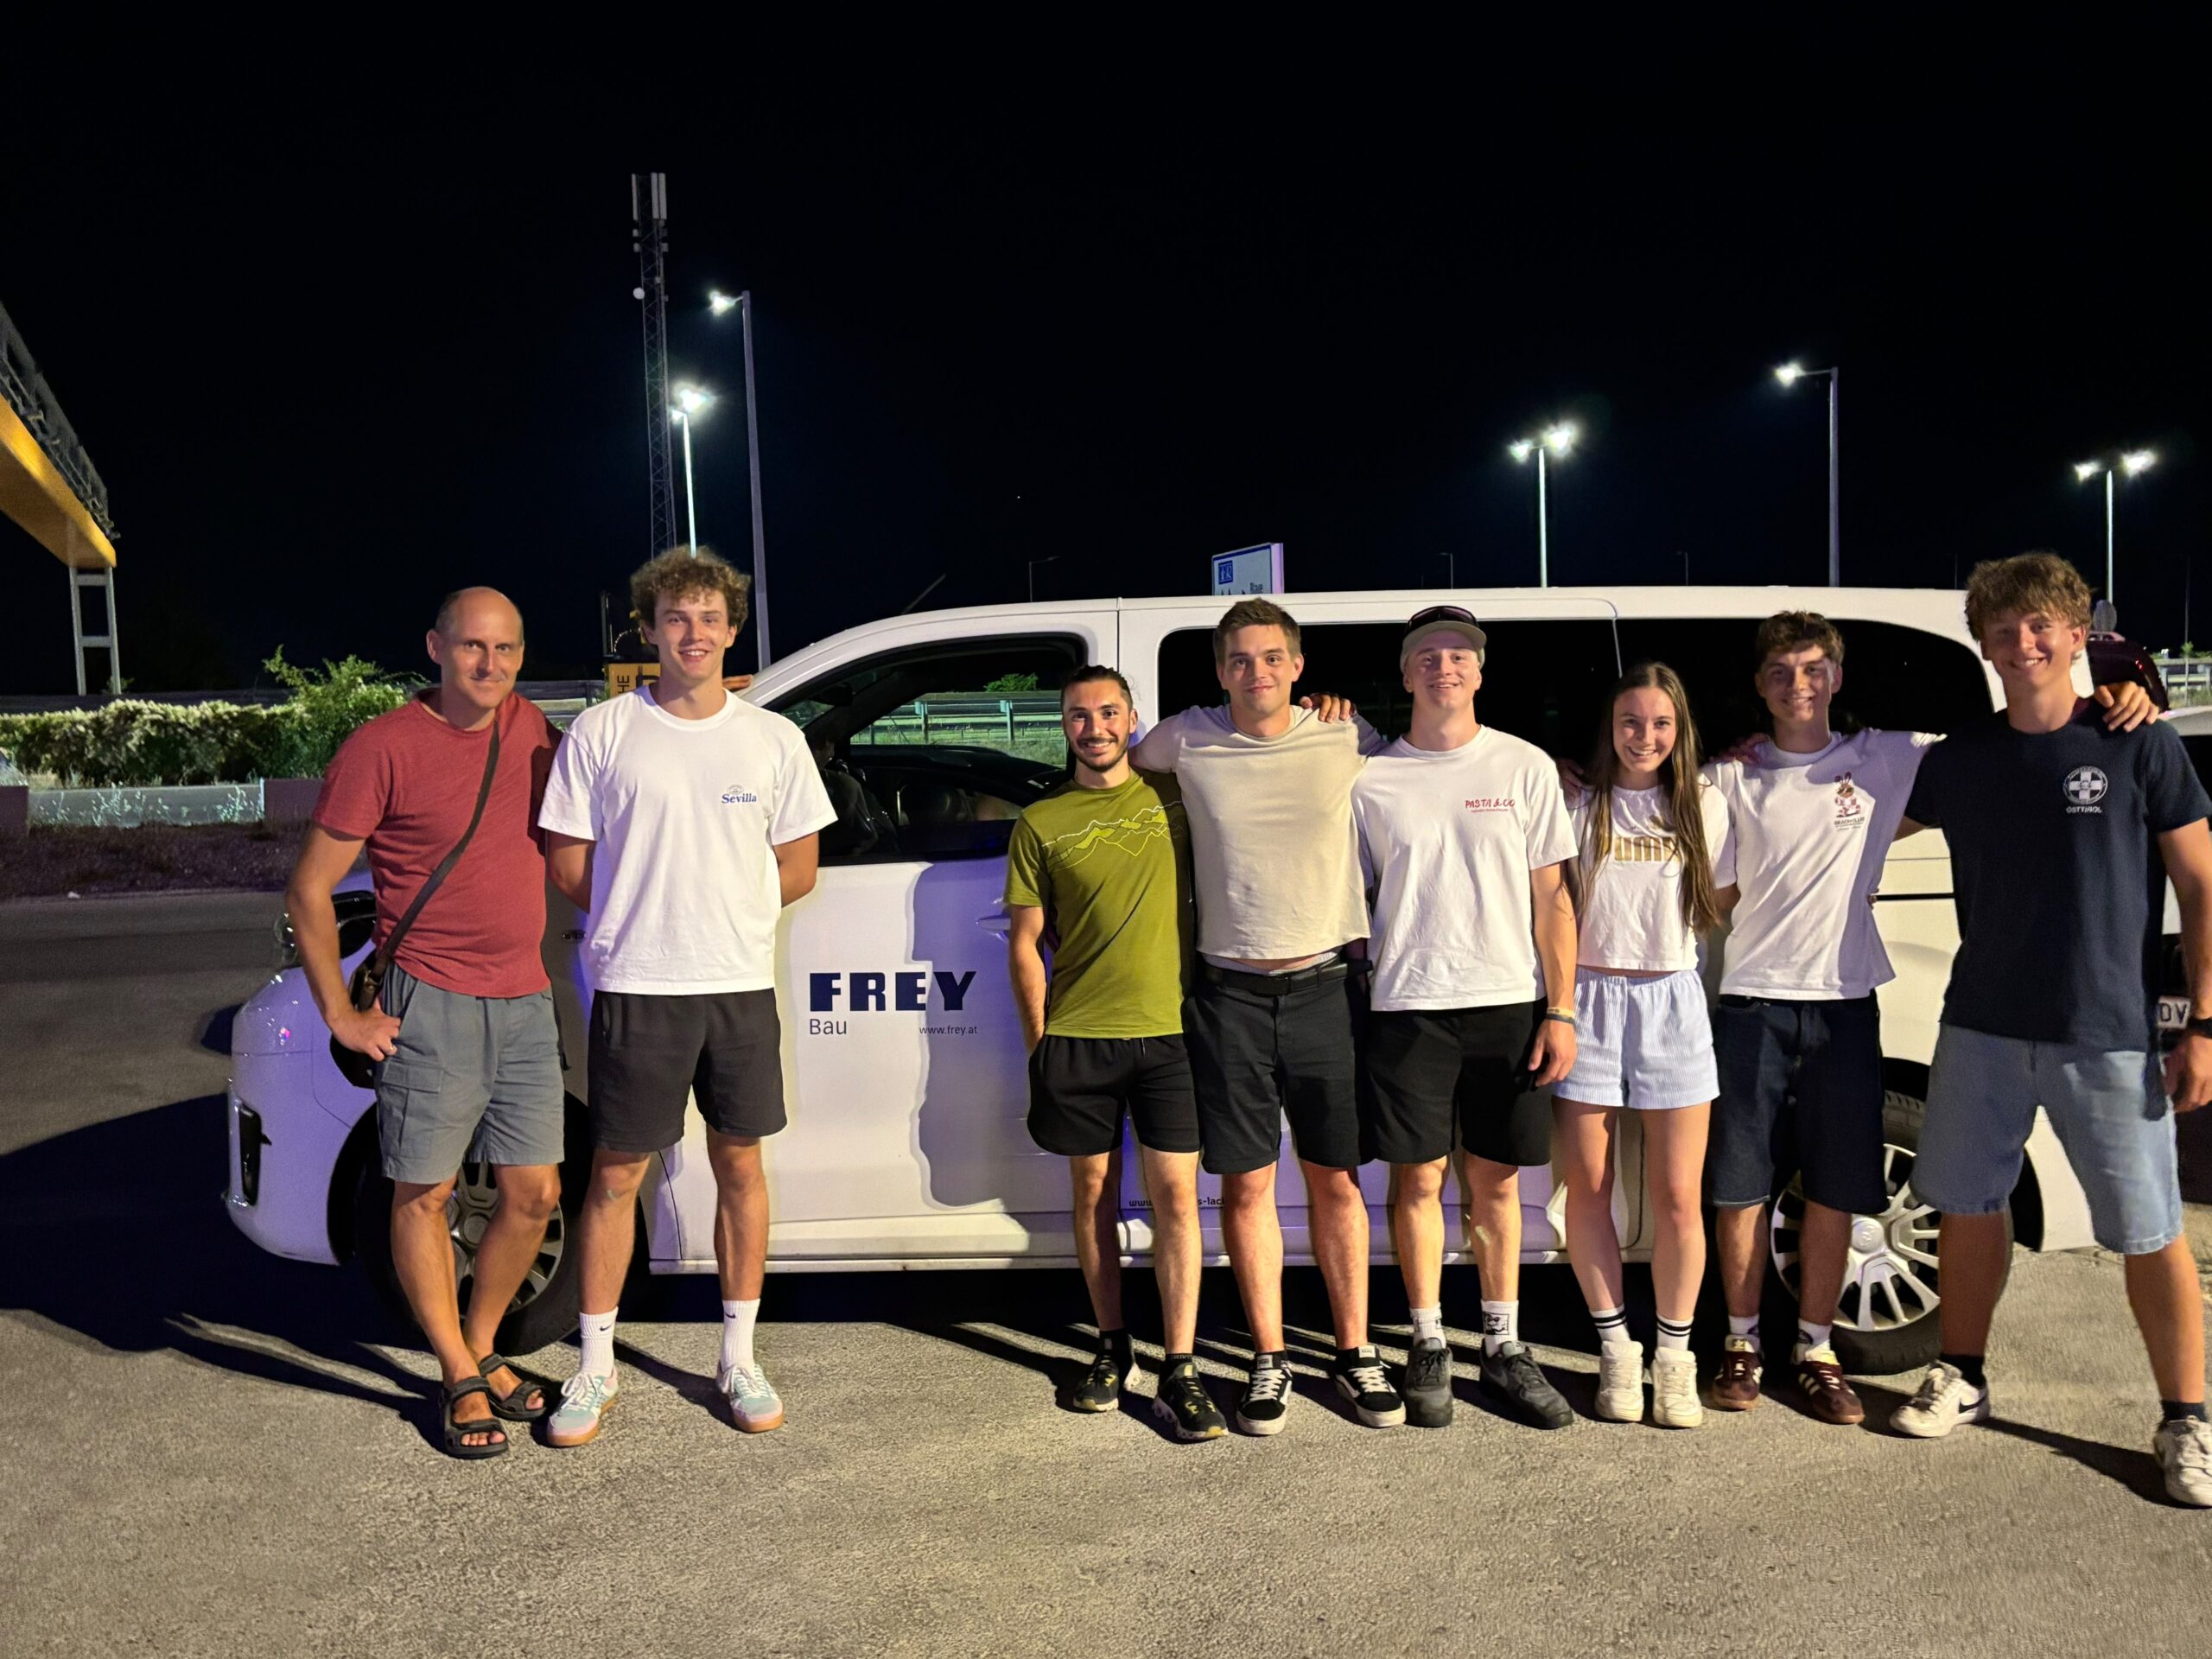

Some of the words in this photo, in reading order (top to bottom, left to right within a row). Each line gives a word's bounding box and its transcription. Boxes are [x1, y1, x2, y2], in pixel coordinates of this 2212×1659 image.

[721, 792, 757, 804] Sevilla
[1465, 798, 1491, 809] PASTA
[810, 971, 976, 1012] FREY
[810, 1019, 847, 1035] Bau
[919, 1026, 977, 1036] www.frey.at
